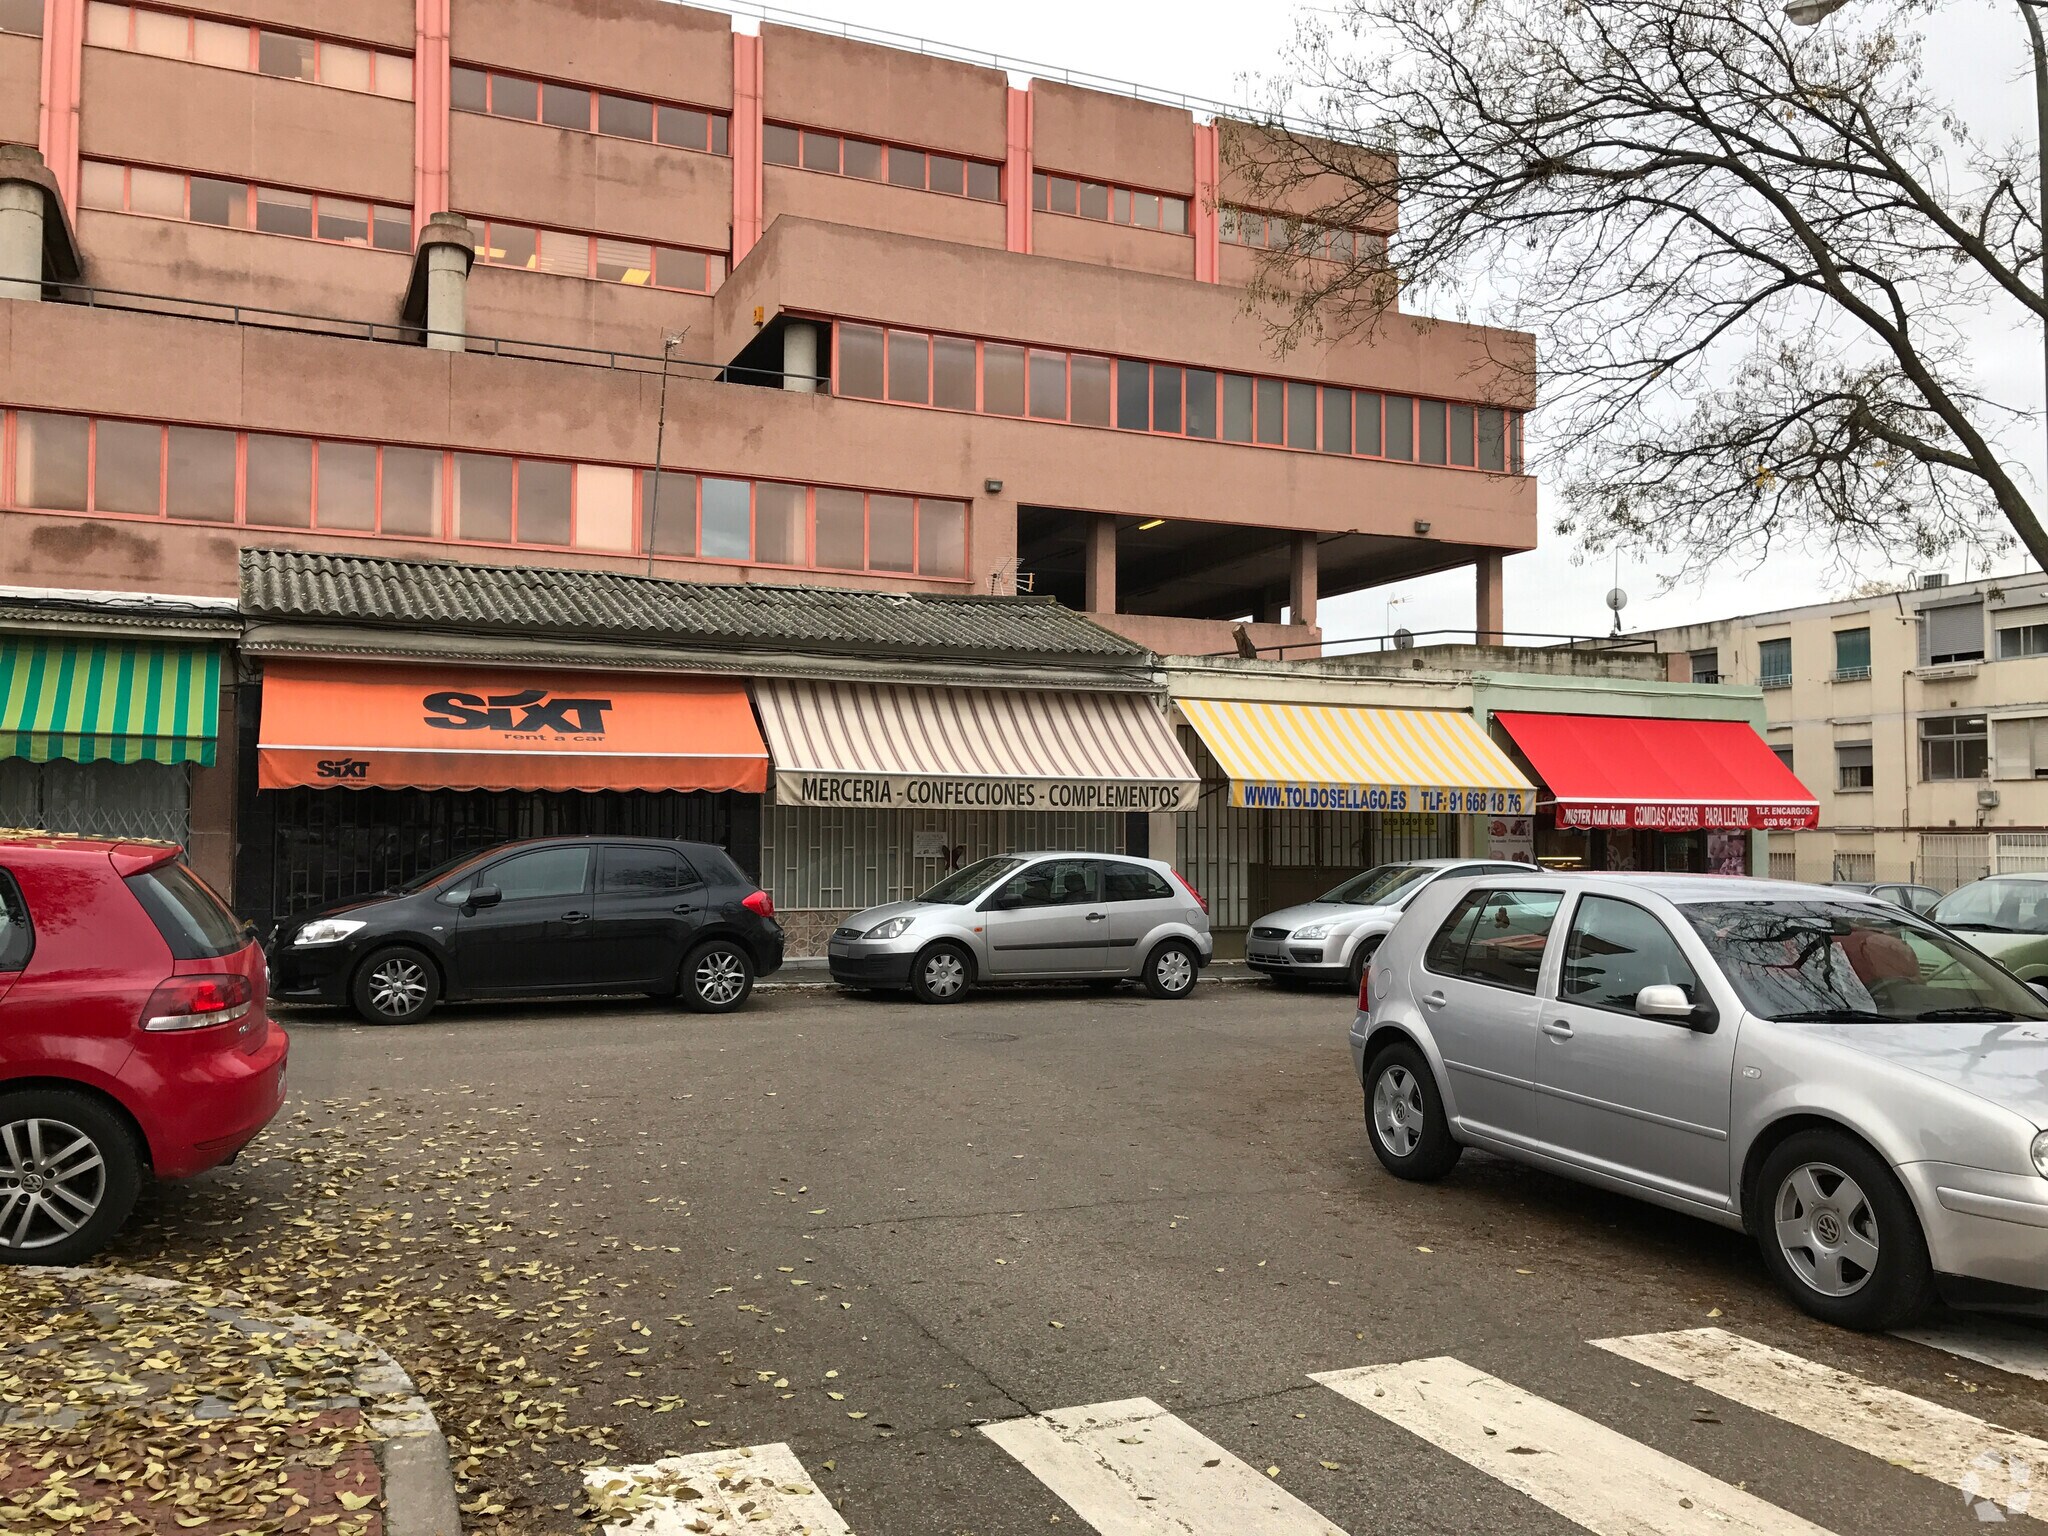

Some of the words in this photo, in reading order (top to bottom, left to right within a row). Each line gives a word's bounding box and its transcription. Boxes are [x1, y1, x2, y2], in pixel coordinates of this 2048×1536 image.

[504, 733, 547, 742] rent
[573, 734, 605, 742] car
[802, 778, 892, 803] MERCERIA
[906, 780, 1035, 806] CONFECCIONES
[1049, 784, 1179, 808] COMPLEMENTOS
[1245, 785, 1407, 811] WWW.TOLDOSELLAGO.ES
[1421, 791, 1447, 811] TLF:
[1466, 792, 1487, 812] 668
[1491, 794, 1504, 812] 18
[1507, 794, 1522, 813] 76
[1634, 806, 1665, 826] COMIDAS
[1666, 806, 1698, 826] CASERAS
[1705, 807, 1723, 826] PARA
[1724, 807, 1749, 826] LLEVAR
[1756, 807, 1770, 815] TLF.
[1763, 818, 1778, 826] 620
